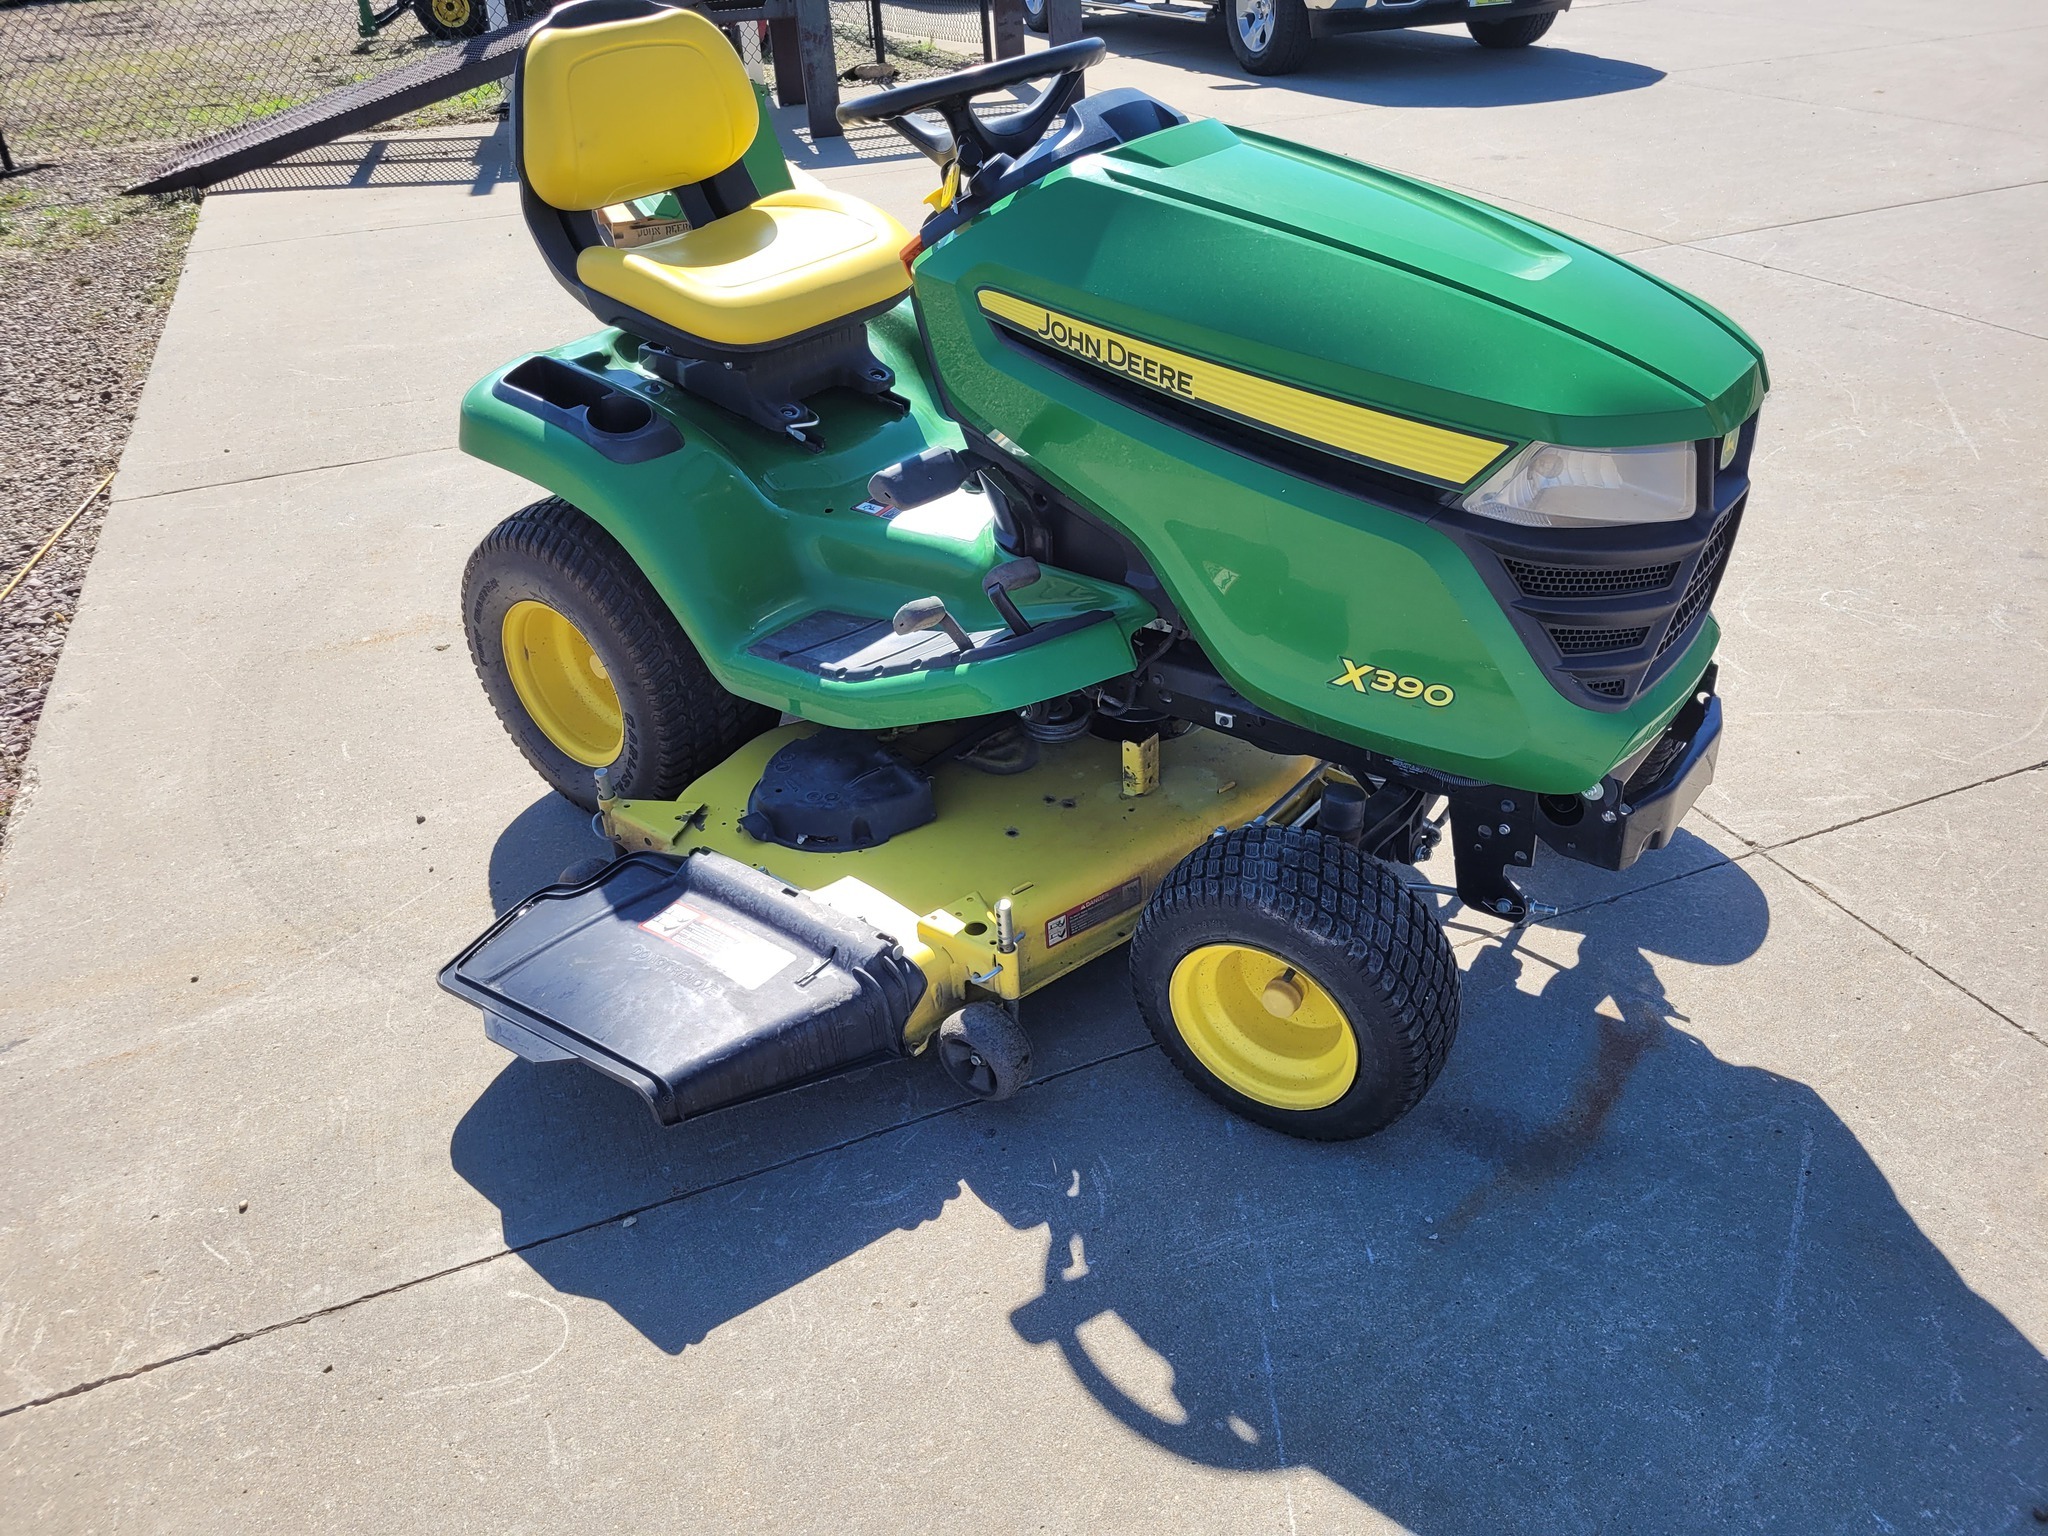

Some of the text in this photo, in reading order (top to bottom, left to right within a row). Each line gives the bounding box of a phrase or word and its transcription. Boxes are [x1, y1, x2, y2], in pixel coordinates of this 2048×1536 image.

[1038, 313, 1194, 397] JOHN DEERE
[1326, 655, 1455, 708] X390
